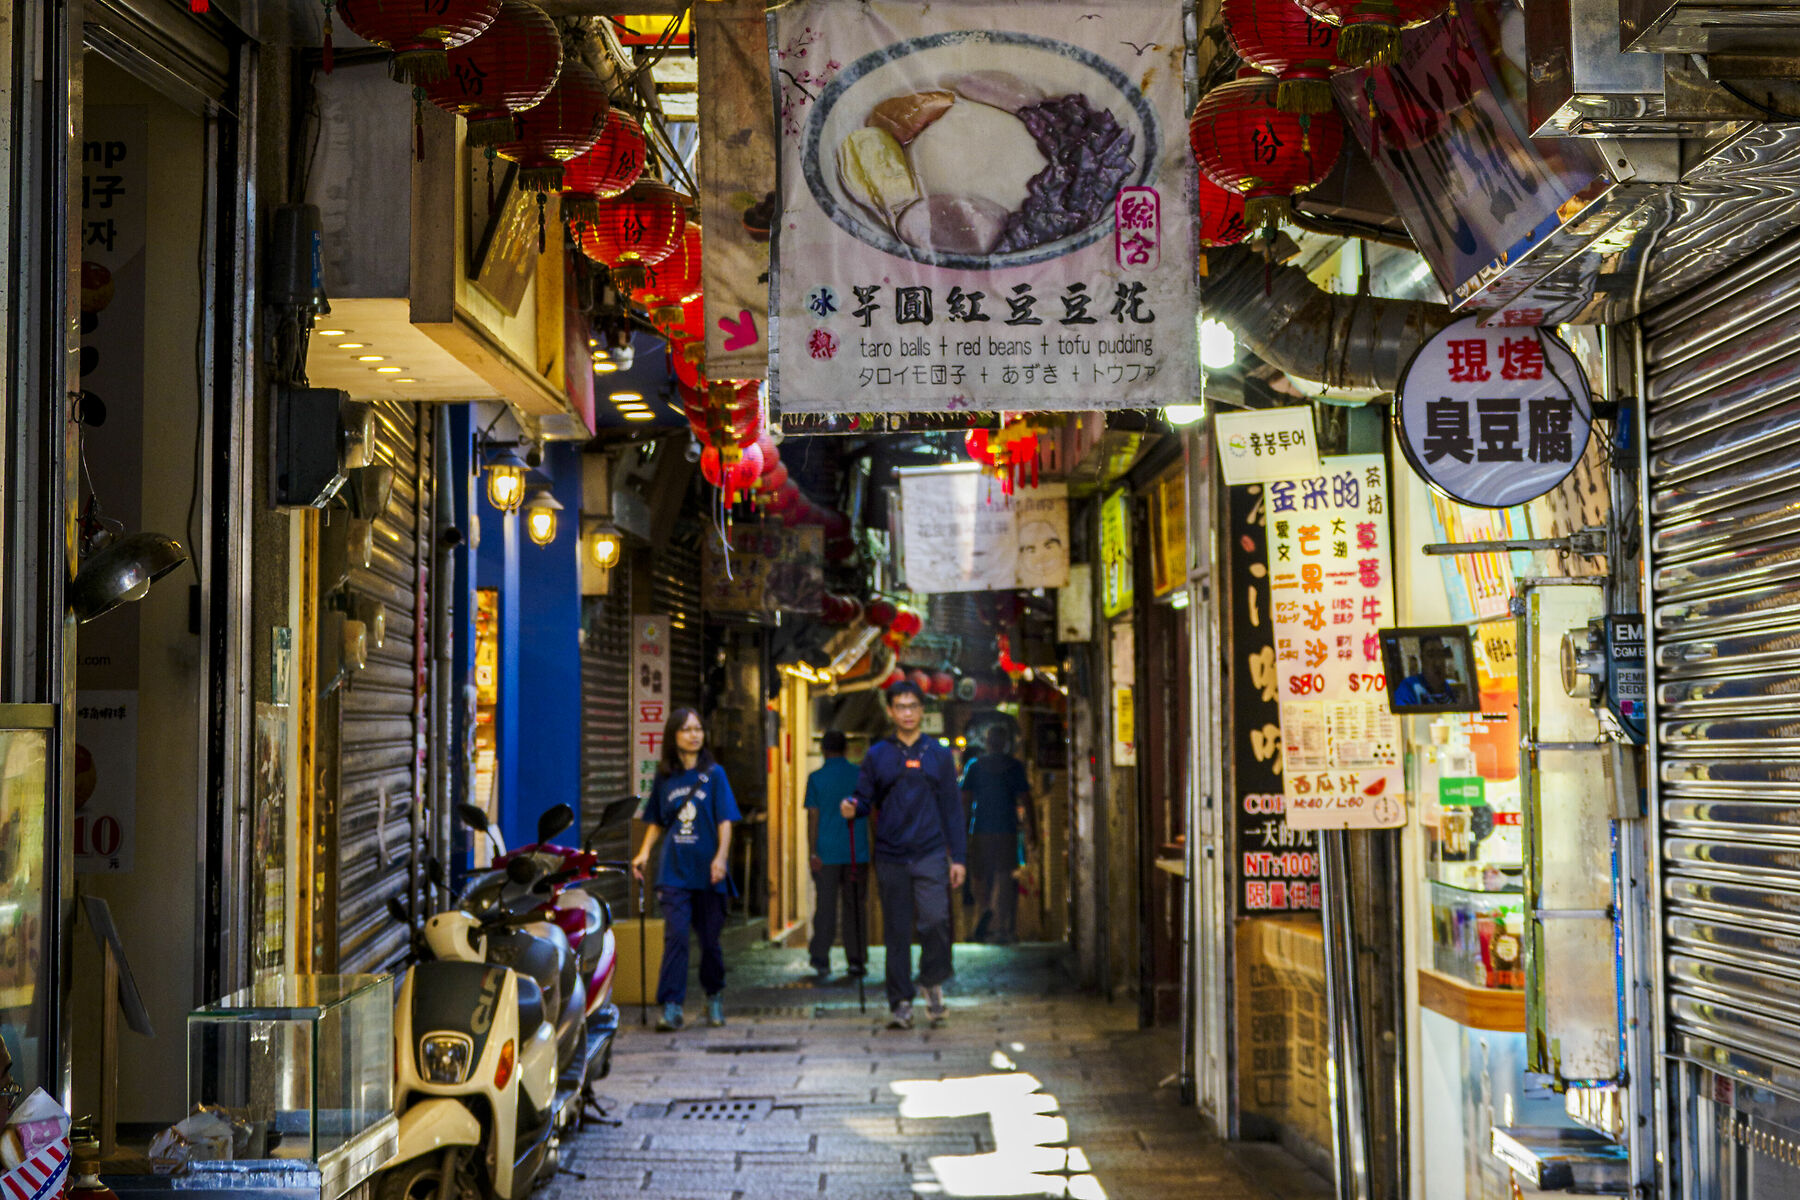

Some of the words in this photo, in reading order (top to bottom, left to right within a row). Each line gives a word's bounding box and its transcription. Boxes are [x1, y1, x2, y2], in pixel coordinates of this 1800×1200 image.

[82, 219, 117, 252] 자
[1121, 196, 1155, 266] 綜合
[810, 288, 838, 318] 冰
[852, 281, 1156, 327] 芋圓紅豆豆花
[808, 328, 837, 359] 熱
[860, 339, 892, 357] taro
[900, 336, 931, 357] balls
[956, 336, 982, 357] red
[988, 335, 1032, 356] beans
[1057, 335, 1091, 355] tofu
[1098, 333, 1154, 357] pudding
[859, 364, 967, 387] タロイモ団子
[1002, 363, 1058, 385] あずき
[1446, 336, 1545, 383] 現烤
[1423, 396, 1574, 465] 臭豆腐
[1297, 524, 1328, 668] 芒果冰沙
[1289, 673, 1325, 695] $80
[1349, 672, 1387, 693] $70
[1292, 772, 1360, 795] 西瓜汁
